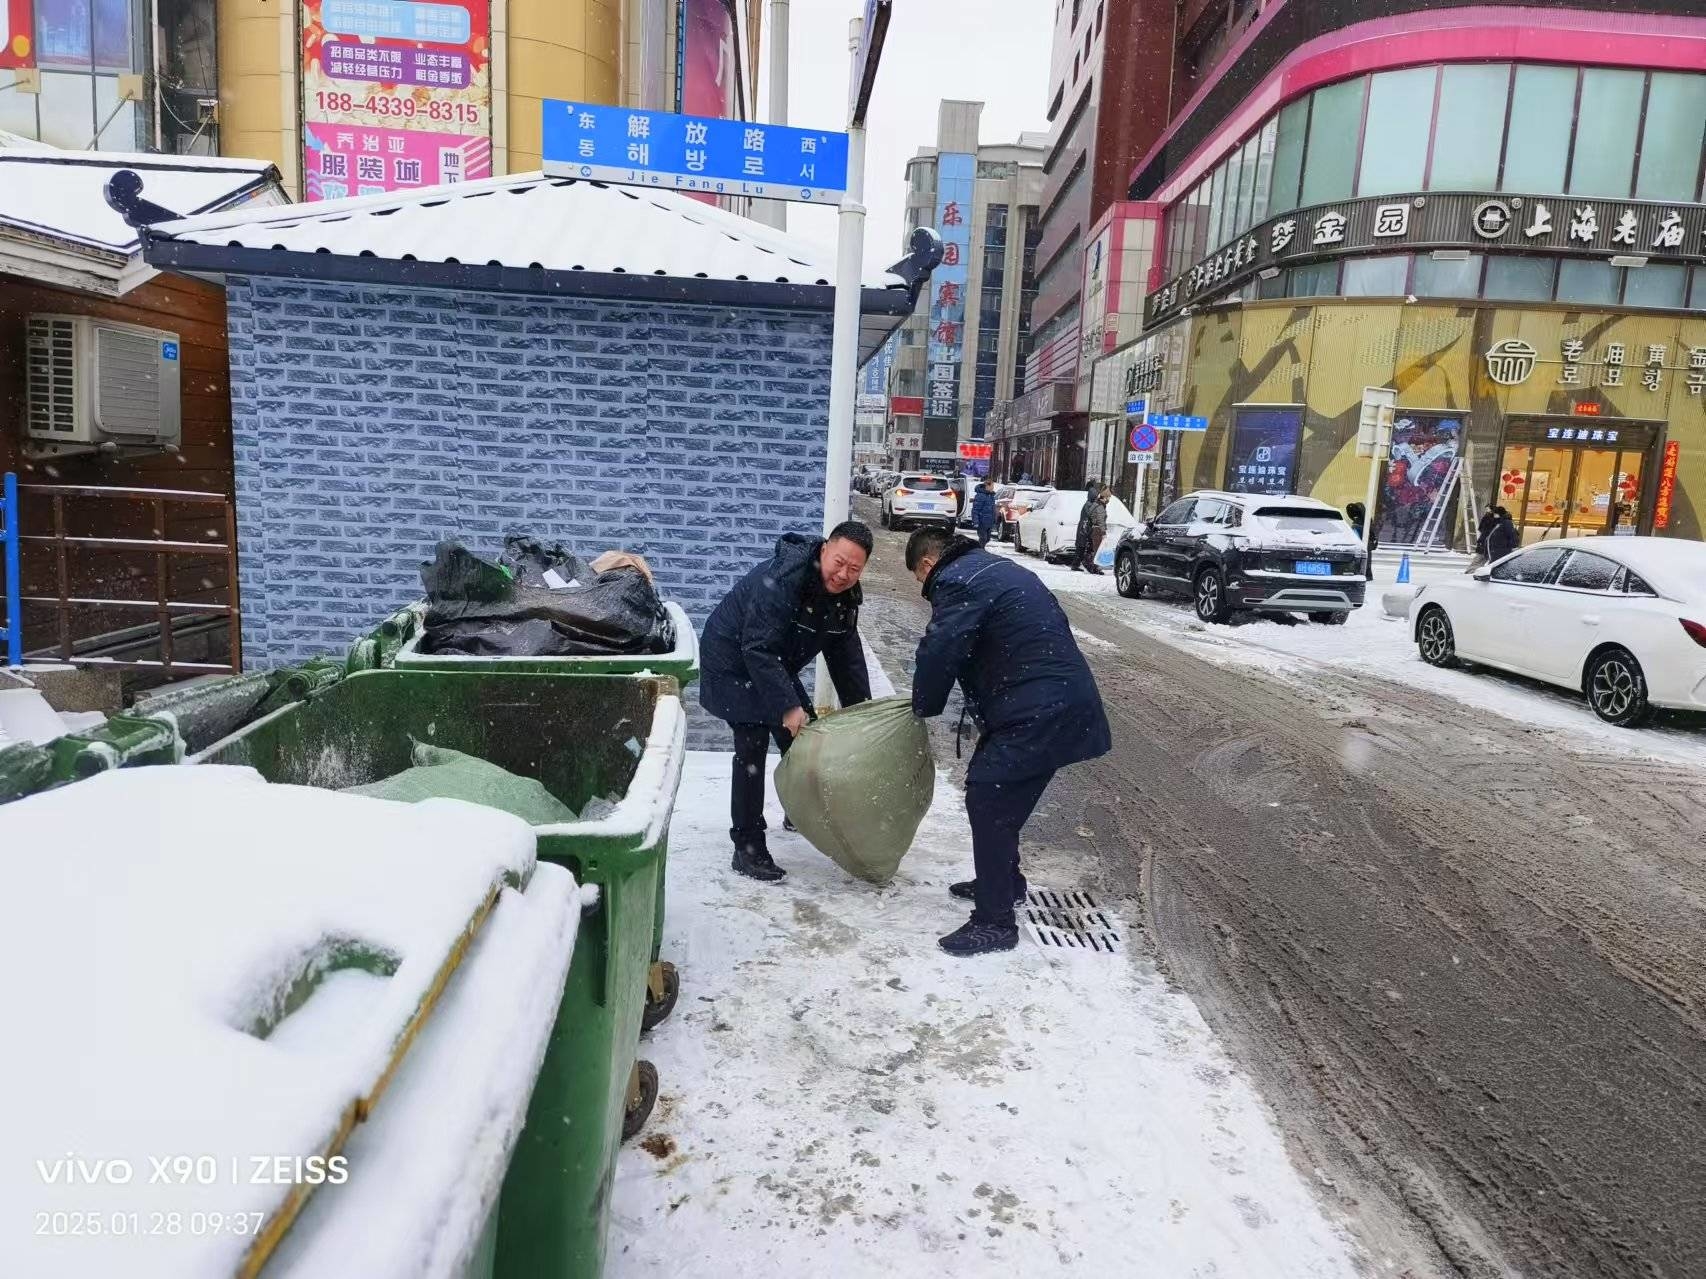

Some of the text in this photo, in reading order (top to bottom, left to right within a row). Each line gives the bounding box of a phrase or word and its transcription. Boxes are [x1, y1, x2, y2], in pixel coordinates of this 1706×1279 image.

[316, 91, 478, 123] 188-4339-8315
[336, 133, 405, 153] 乔治亚
[578, 112, 596, 129] 东
[627, 114, 764, 152] 解放路
[800, 137, 816, 154] 西
[322, 154, 420, 182] 服装城
[578, 139, 815, 181] 동 해방로 서
[627, 172, 764, 195] Jie Fang Lu
[1271, 203, 1411, 252] 梦金园
[1524, 203, 1706, 248] 上海老庙
